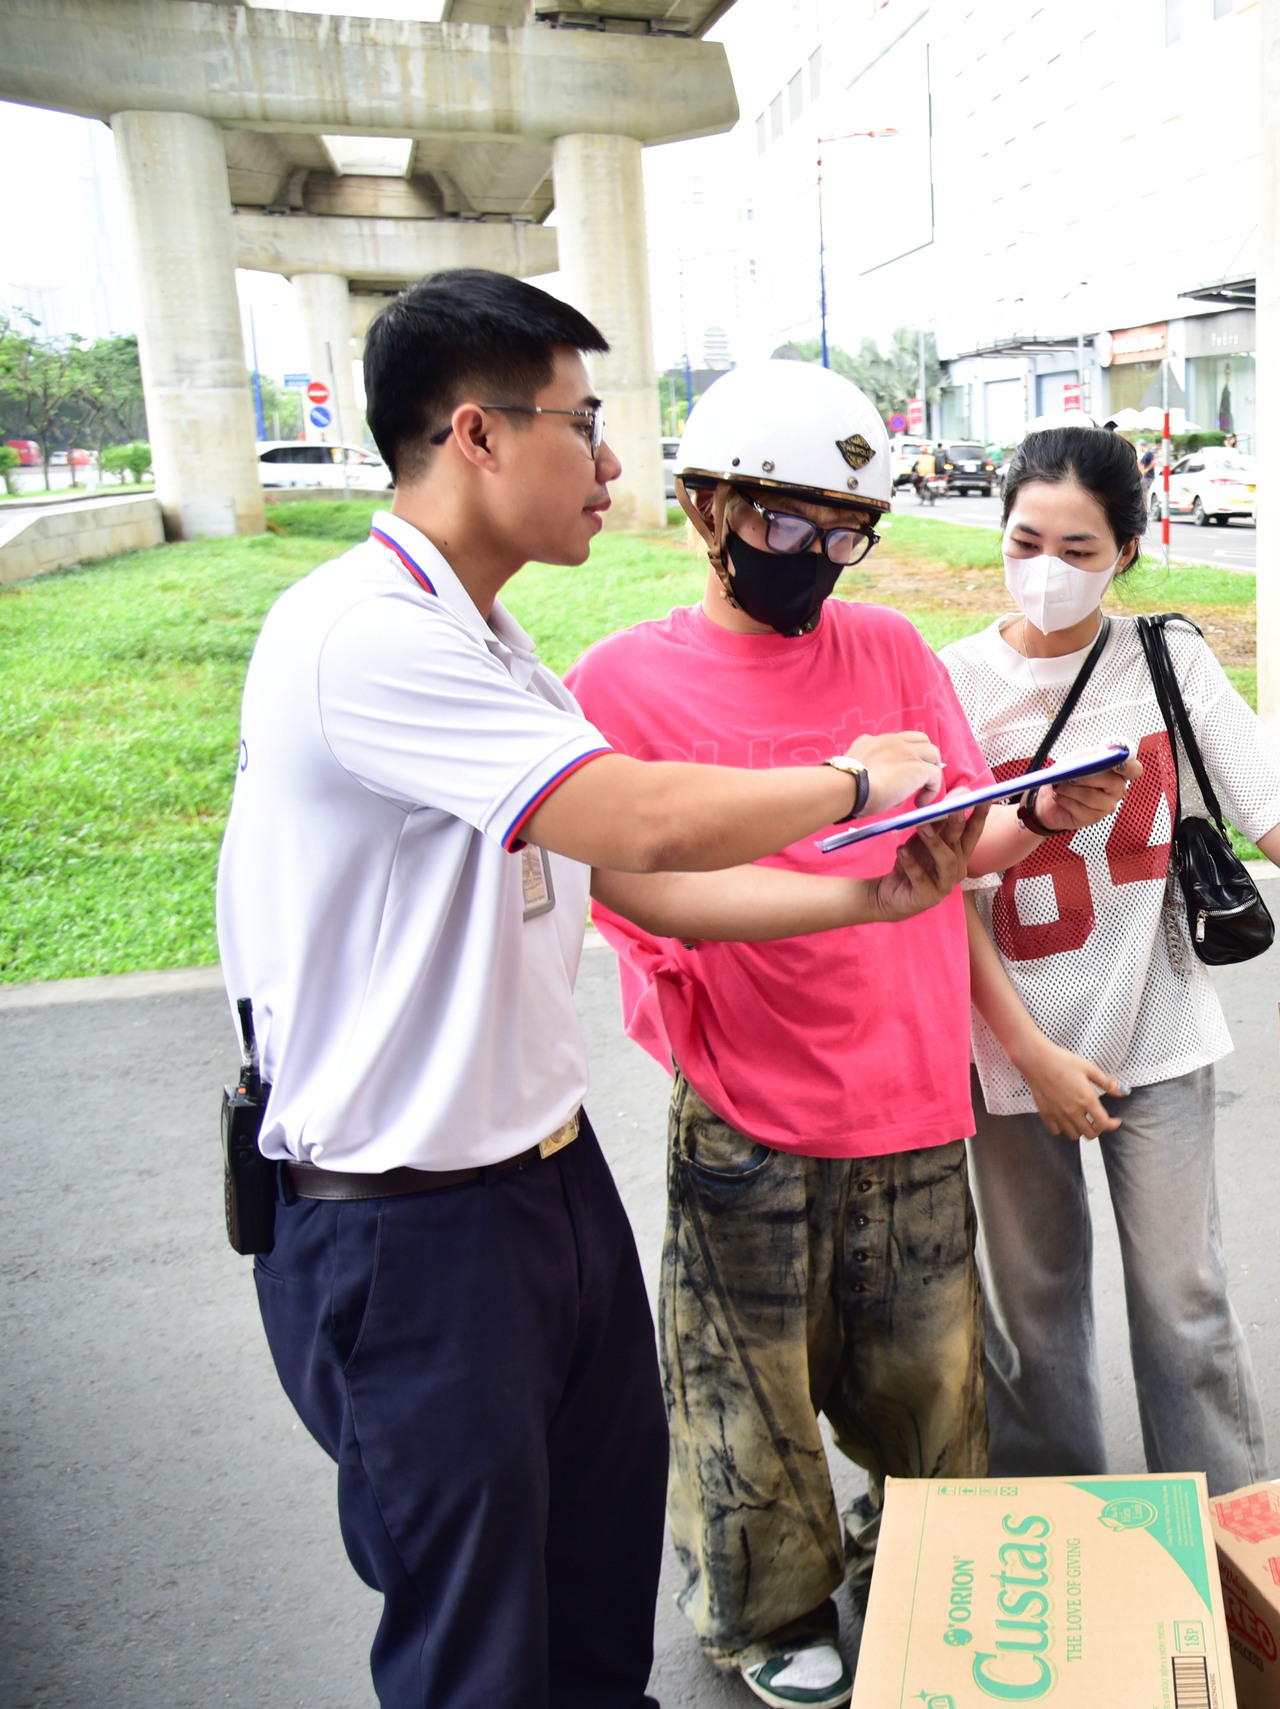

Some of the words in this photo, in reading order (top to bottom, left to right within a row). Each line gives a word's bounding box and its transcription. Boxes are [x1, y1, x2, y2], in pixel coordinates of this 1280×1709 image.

[1067, 1538, 1081, 1577] GIVING
[950, 1558, 975, 1623] ORION
[1067, 1579, 1082, 1597] OF
[972, 1512, 1052, 1703] Custas
[1067, 1599, 1082, 1632] LOVE
[1067, 1634, 1082, 1662] THE
[1184, 1626, 1201, 1647] 18P
